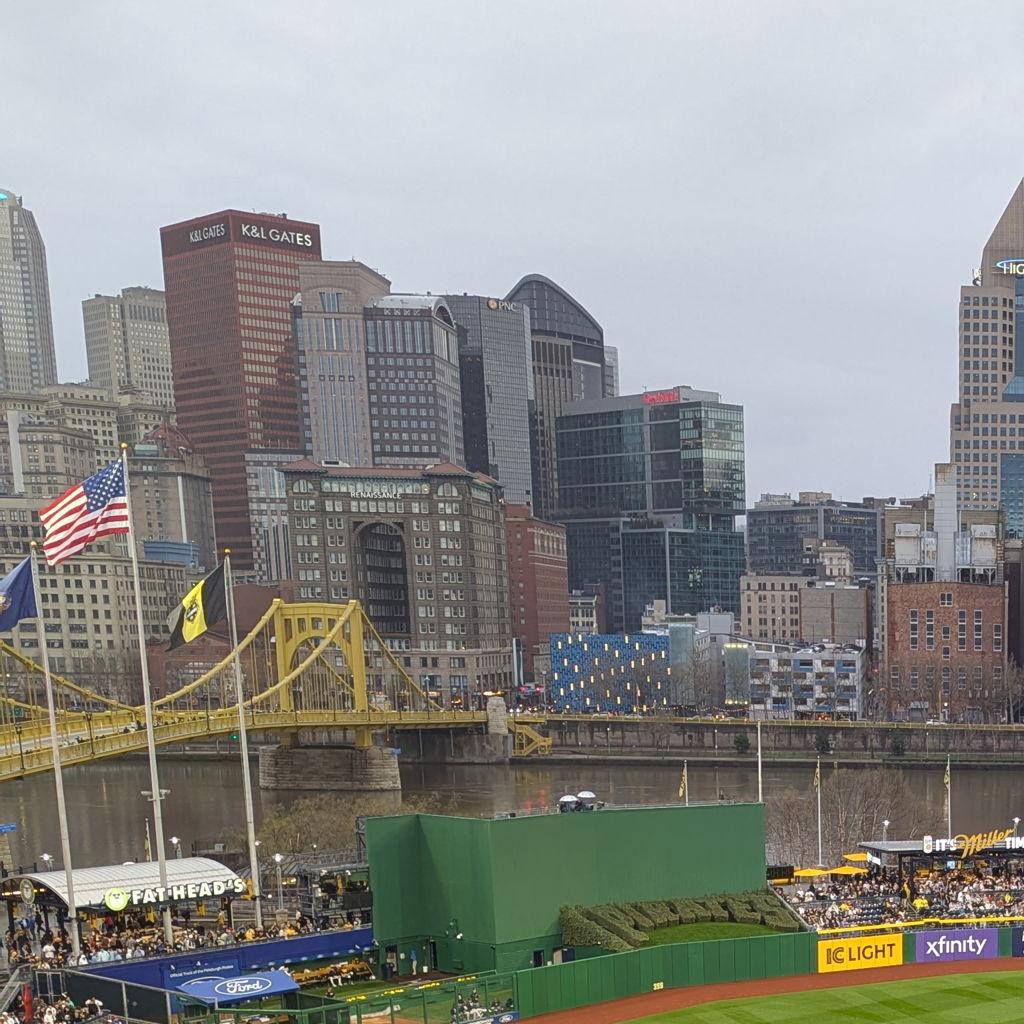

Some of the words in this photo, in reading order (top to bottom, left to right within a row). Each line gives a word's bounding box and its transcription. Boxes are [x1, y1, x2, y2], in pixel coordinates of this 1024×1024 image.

[189, 231, 202, 243] K&L
[203, 224, 225, 240] GATES
[241, 224, 267, 239] K&L
[269, 228, 312, 247] GATES
[498, 301, 518, 311] PNC
[350, 491, 402, 499] RENAISSANCE
[935, 838, 957, 851] IT'S
[955, 827, 1015, 859] Miller
[131, 887, 166, 905] FAT
[172, 878, 244, 900] HEAD'S
[826, 946, 845, 965] IC
[849, 943, 896, 962] LIGHT
[925, 935, 987, 957] xfinity
[226, 979, 263, 993] Ford
